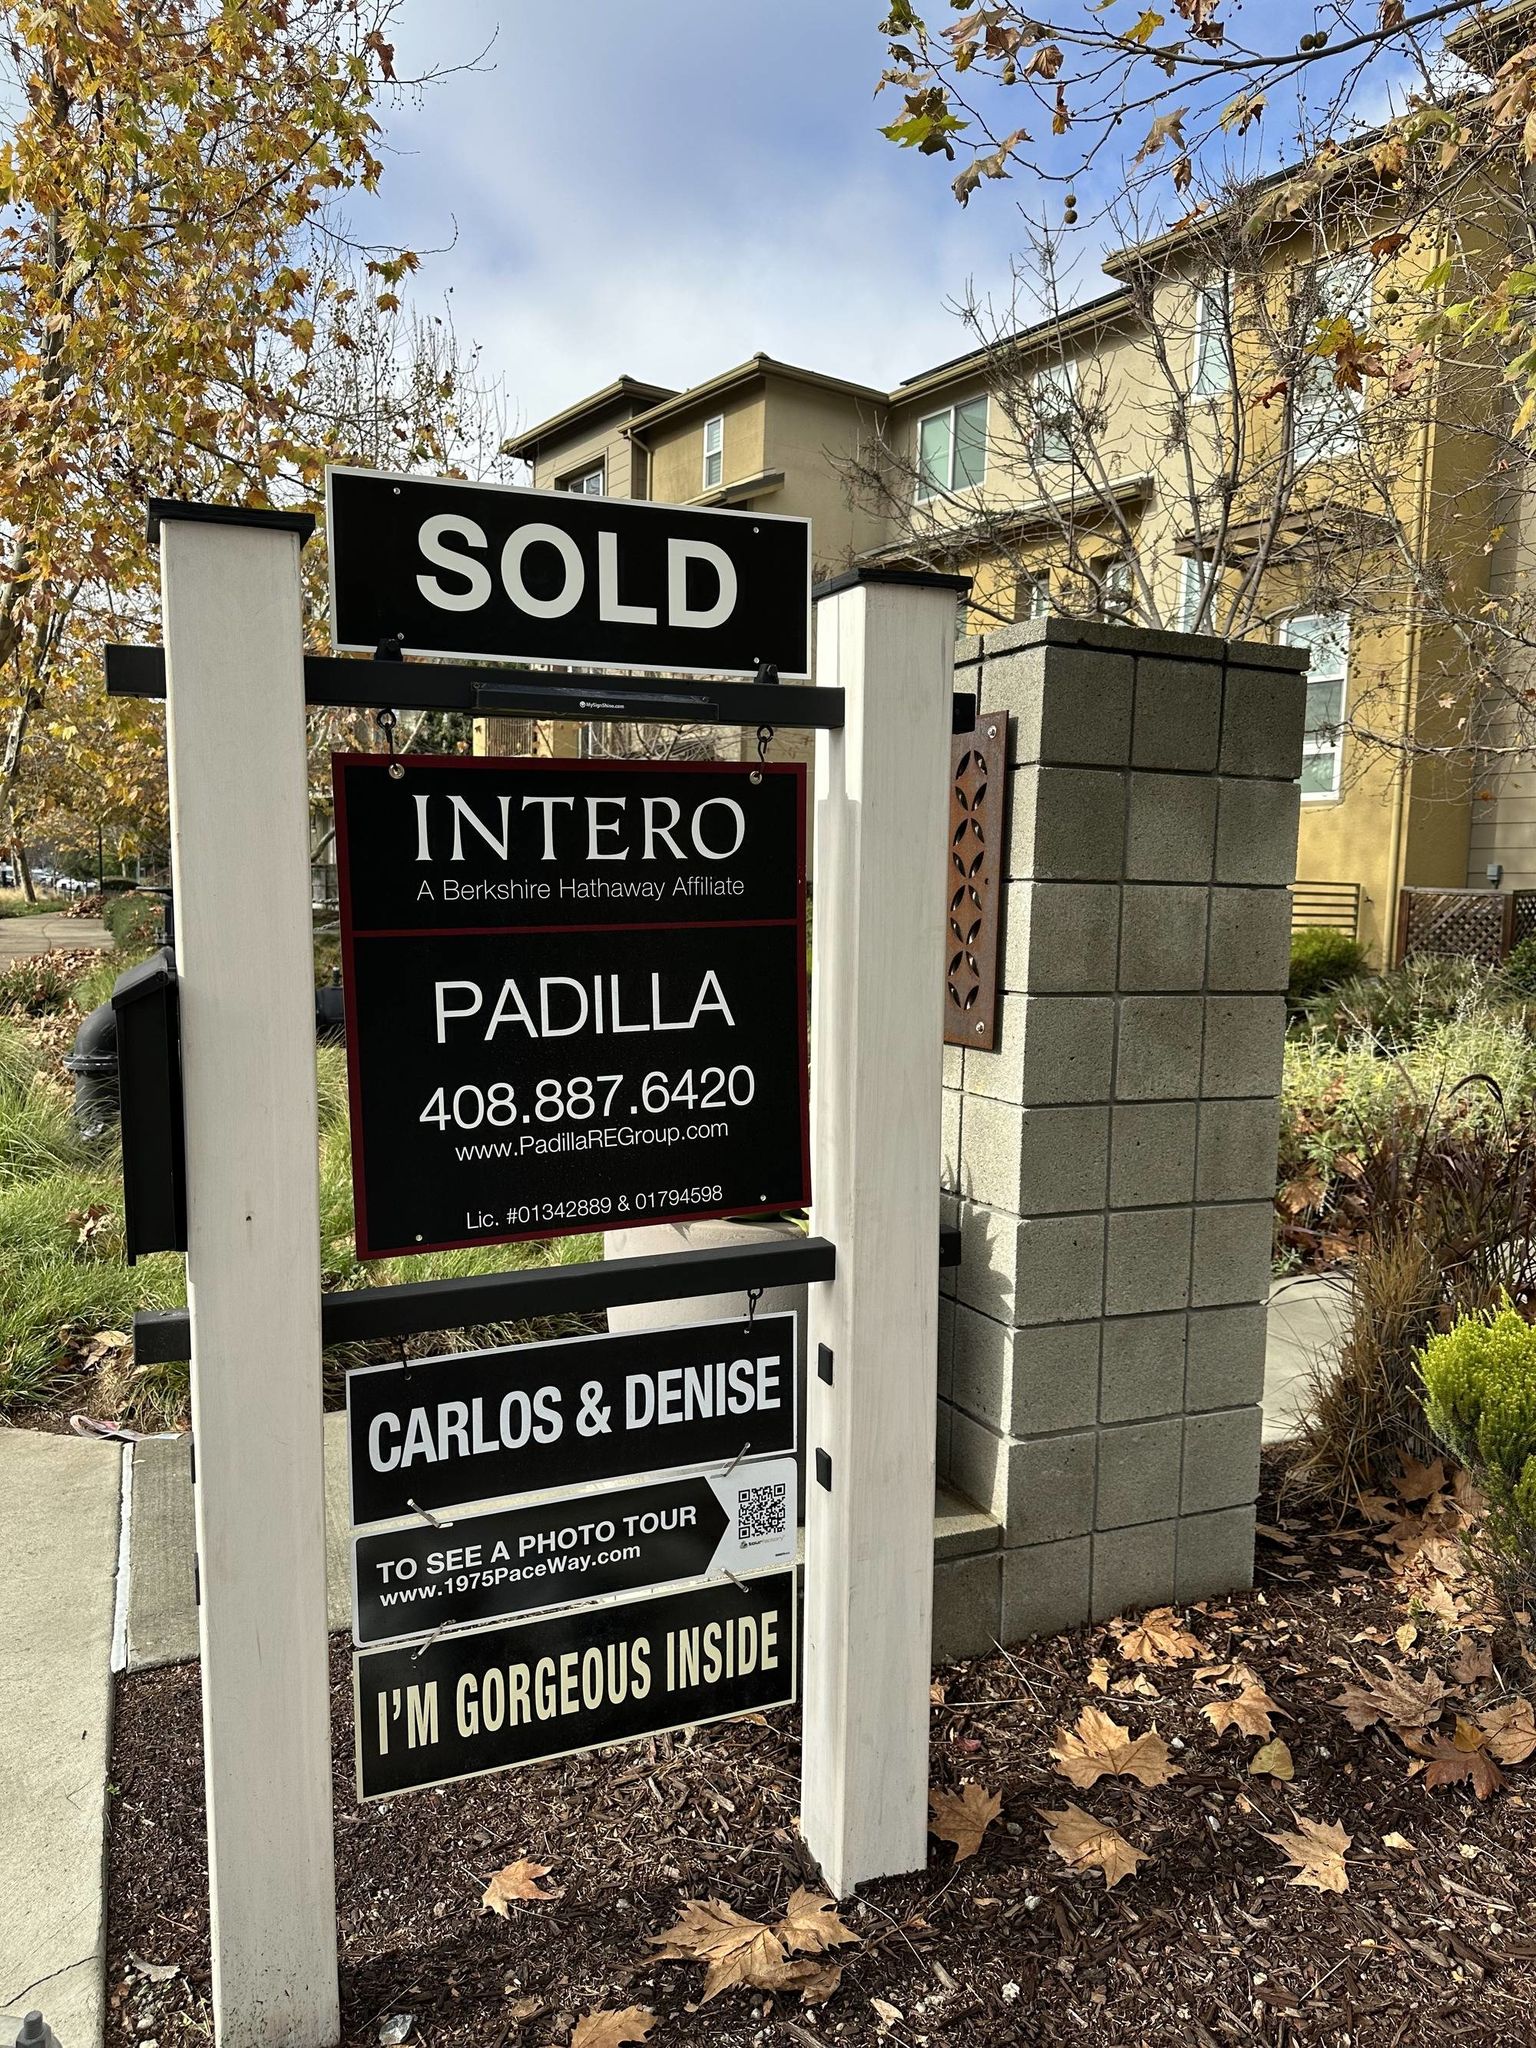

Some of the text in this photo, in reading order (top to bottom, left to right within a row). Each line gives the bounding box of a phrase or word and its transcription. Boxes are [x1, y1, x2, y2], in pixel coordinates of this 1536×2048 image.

[416, 513, 738, 630] SOLD
[411, 794, 746, 862] INTERO
[416, 876, 745, 901] A Berkshire Hathaway Affiliate
[434, 969, 736, 1044] PADILLA
[418, 1064, 756, 1132] 408.887.6420
[455, 1119, 729, 1162] www.PadillaREGroup.com
[466, 1184, 723, 1231] Lic. #01342889 & 01794598
[367, 1355, 782, 1474] CARLOS & DENISE
[376, 1505, 697, 1584] TO SEE A PHOTO TOUR
[379, 1542, 641, 1608] www.1975PaceWay.com
[377, 1610, 780, 1756] I'M GORGEOUS INSIDE
